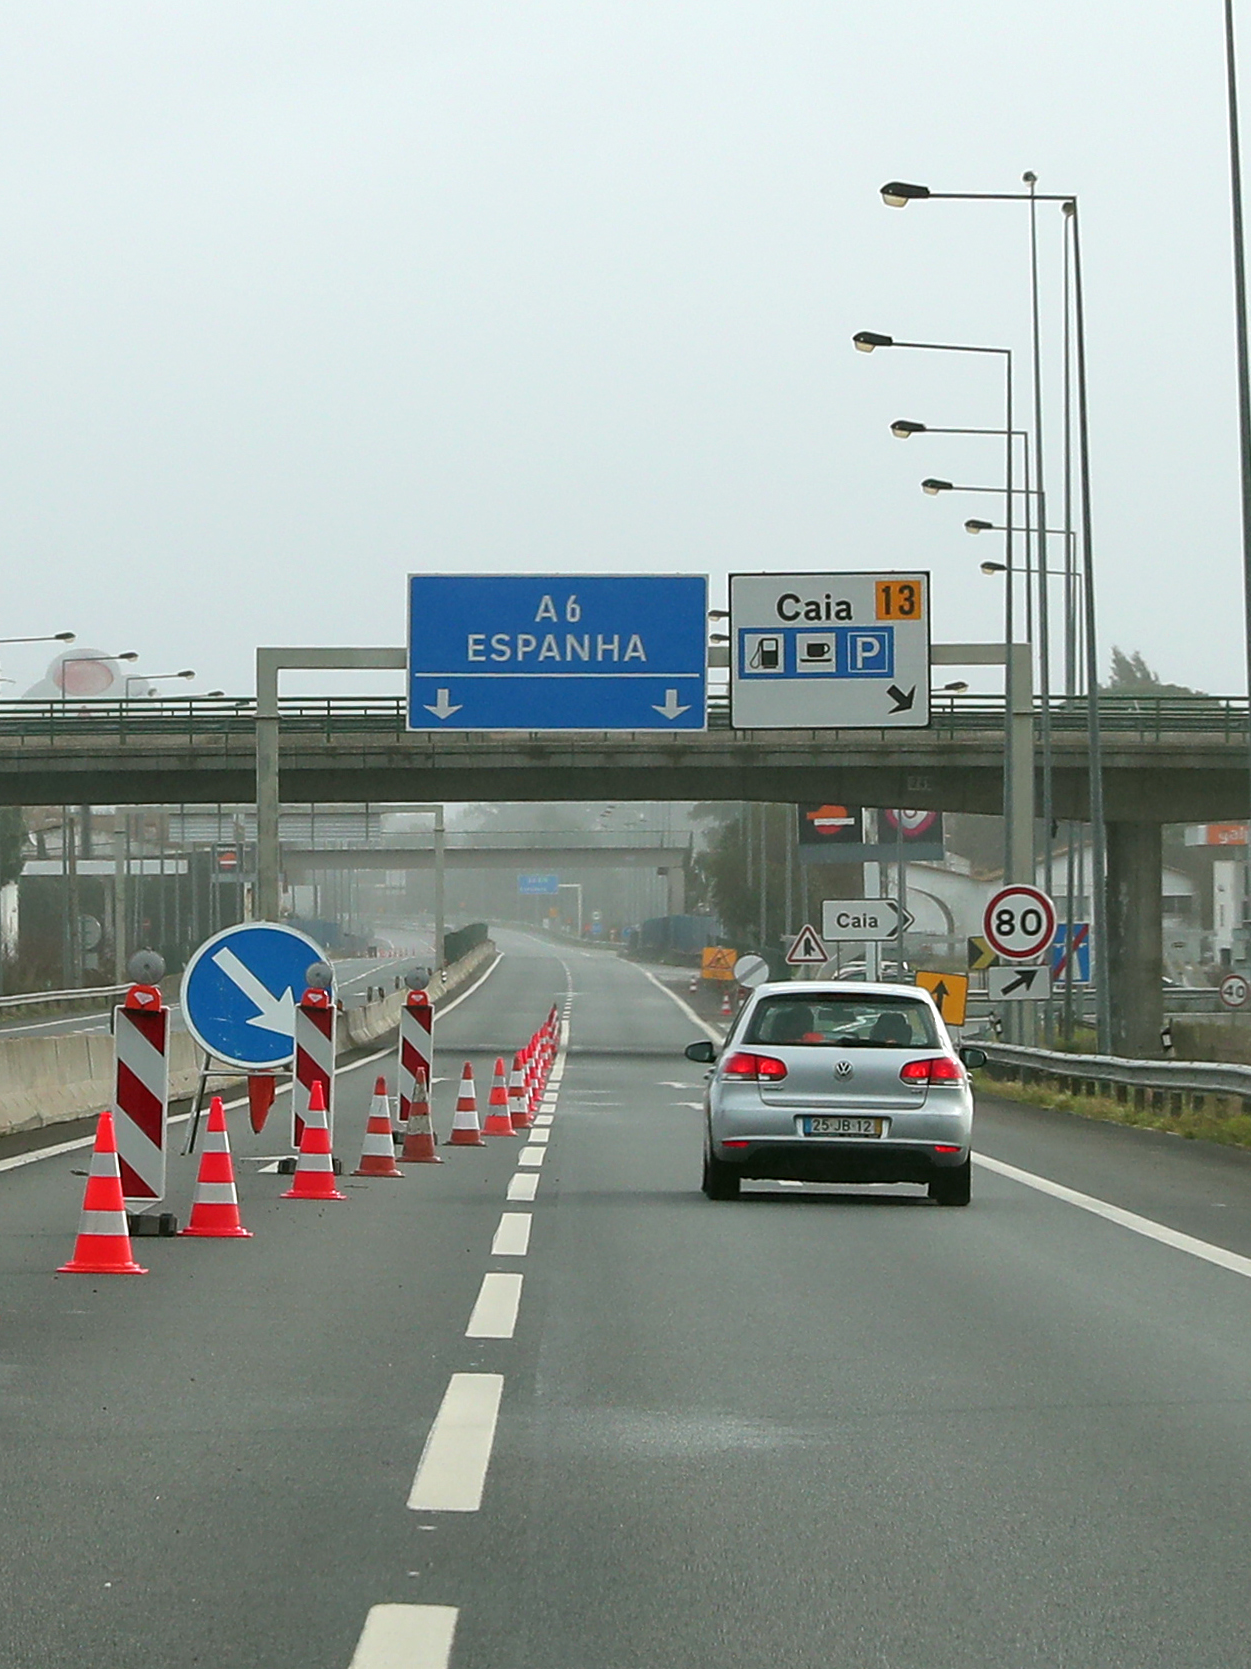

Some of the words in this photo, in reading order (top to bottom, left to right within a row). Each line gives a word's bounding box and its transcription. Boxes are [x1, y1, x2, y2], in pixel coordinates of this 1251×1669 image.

[776, 592, 853, 622] Caia
[881, 584, 915, 616] 13
[467, 633, 648, 662] ESPANHA
[855, 636, 881, 669] P
[836, 912, 879, 929] Caia
[995, 908, 1043, 937] 80
[1223, 984, 1246, 999] 40
